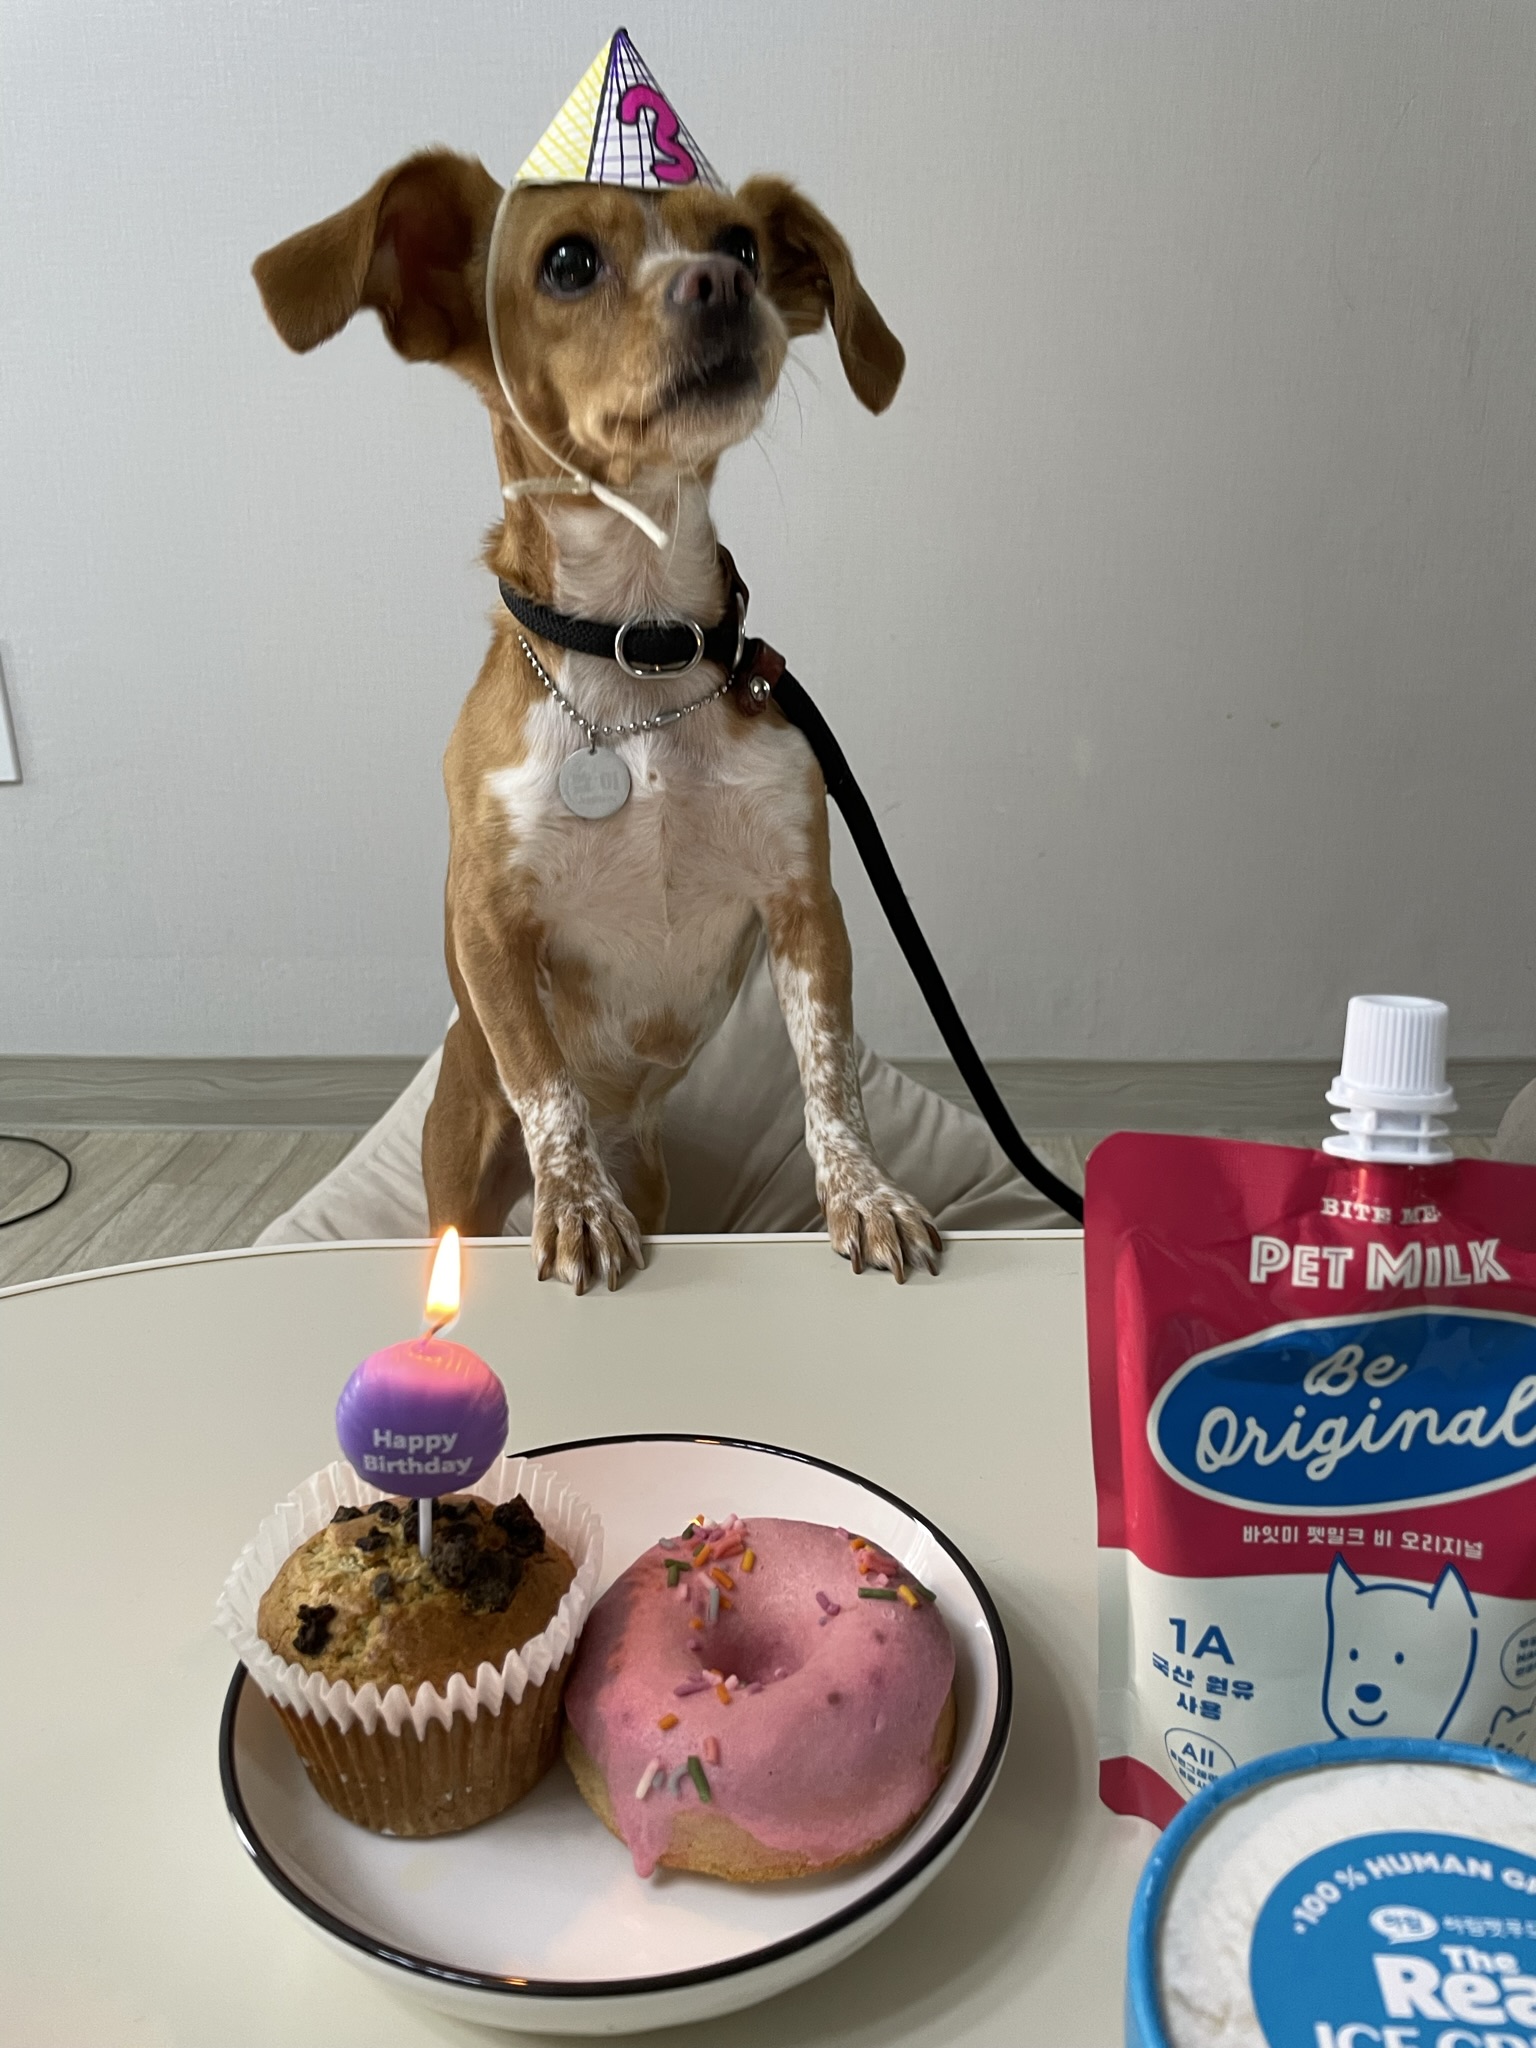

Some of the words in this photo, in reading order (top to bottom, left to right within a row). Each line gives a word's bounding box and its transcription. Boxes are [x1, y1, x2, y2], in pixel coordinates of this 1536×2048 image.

[616, 83, 698, 185] 3
[1320, 1197, 1391, 1224] BITE
[1400, 1205, 1440, 1225] ME
[1249, 1235, 1354, 1289] PET
[1365, 1238, 1511, 1291] MILK
[1303, 1344, 1408, 1396] Be
[372, 1428, 458, 1454] Happy
[1196, 1375, 1536, 1481] Original
[363, 1454, 473, 1476] Birthday
[1242, 1525, 1299, 1544] 바잇미
[1307, 1525, 1365, 1546] 펫밀크
[1374, 1528, 1392, 1547] 비
[1400, 1531, 1484, 1560] 오리지널
[1168, 1617, 1235, 1666] 1A
[1152, 1651, 1195, 1689] 국산
[1206, 1675, 1254, 1700] 원유
[1176, 1692, 1222, 1721] 사용
[1182, 1742, 1214, 1769] All
[1364, 1851, 1494, 1882] HUMAN
[1439, 1944, 1522, 1975] The
